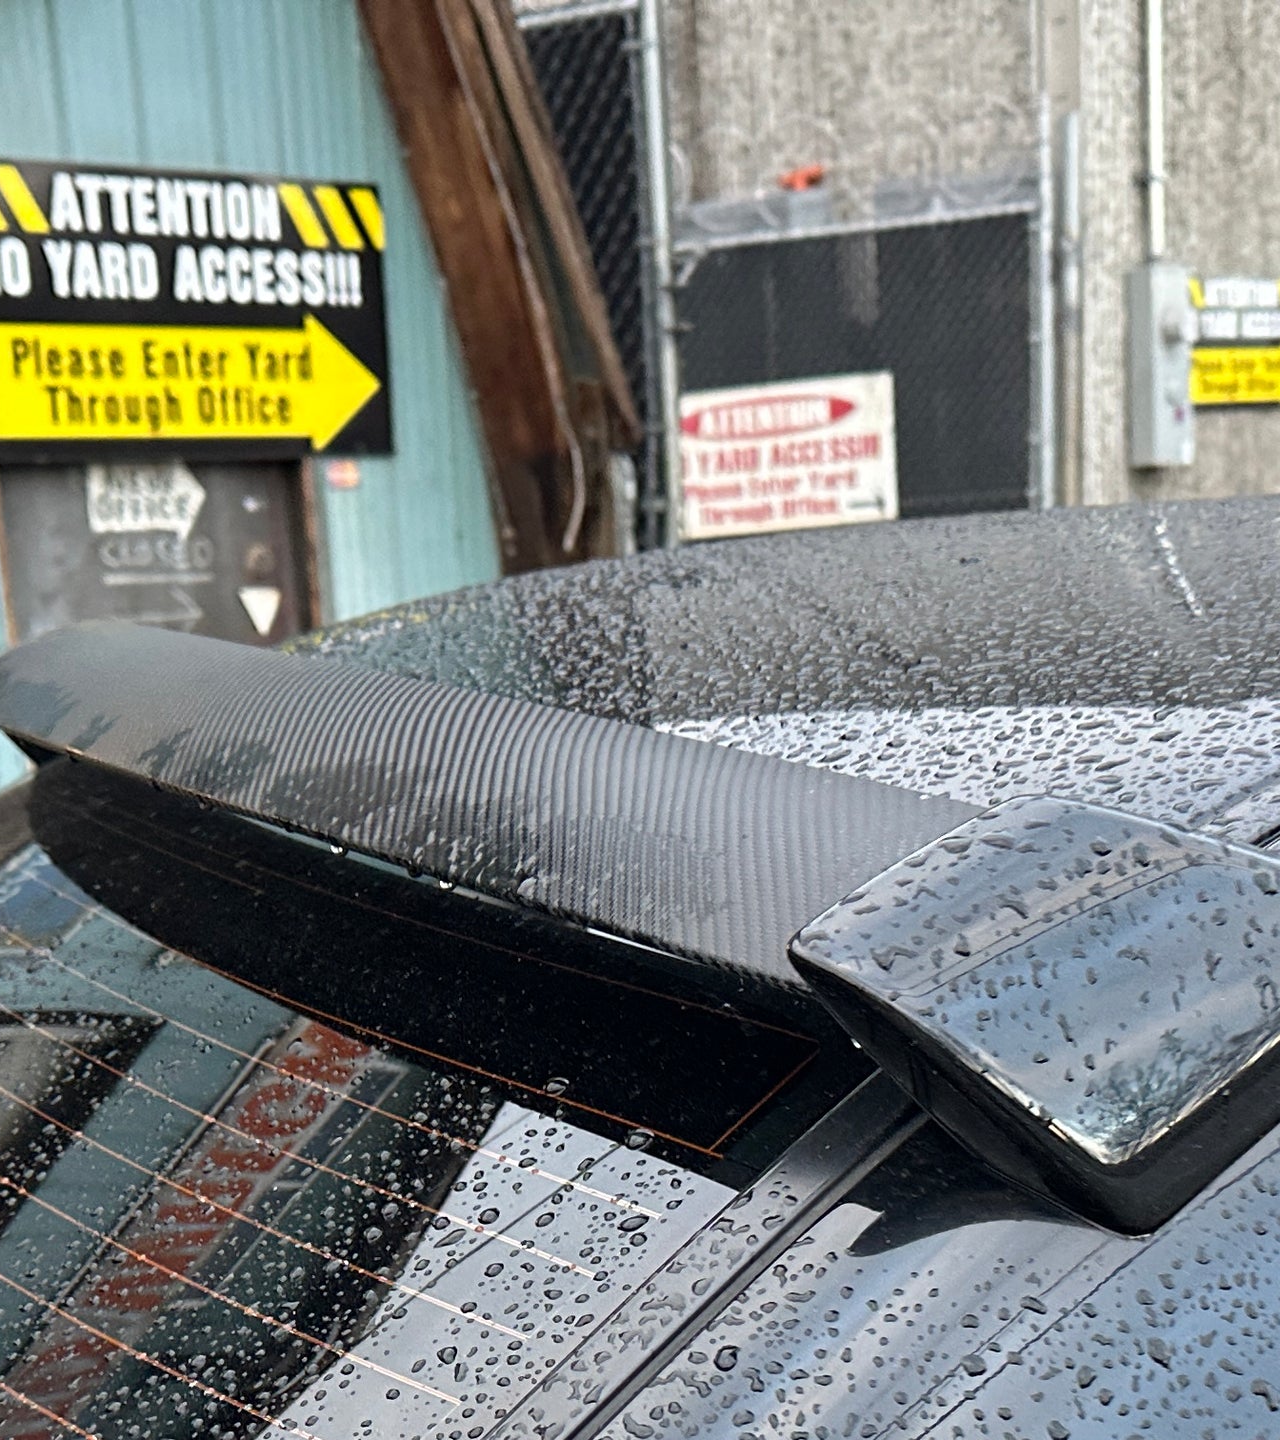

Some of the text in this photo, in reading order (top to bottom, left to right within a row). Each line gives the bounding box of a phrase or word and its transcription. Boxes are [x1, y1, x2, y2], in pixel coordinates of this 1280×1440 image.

[50, 171, 283, 243] ATTENTION
[42, 240, 160, 301] YARD
[173, 245, 364, 308] ACCESS!!!
[10, 337, 313, 382] Please Enter Yard
[43, 386, 293, 433] Through Office
